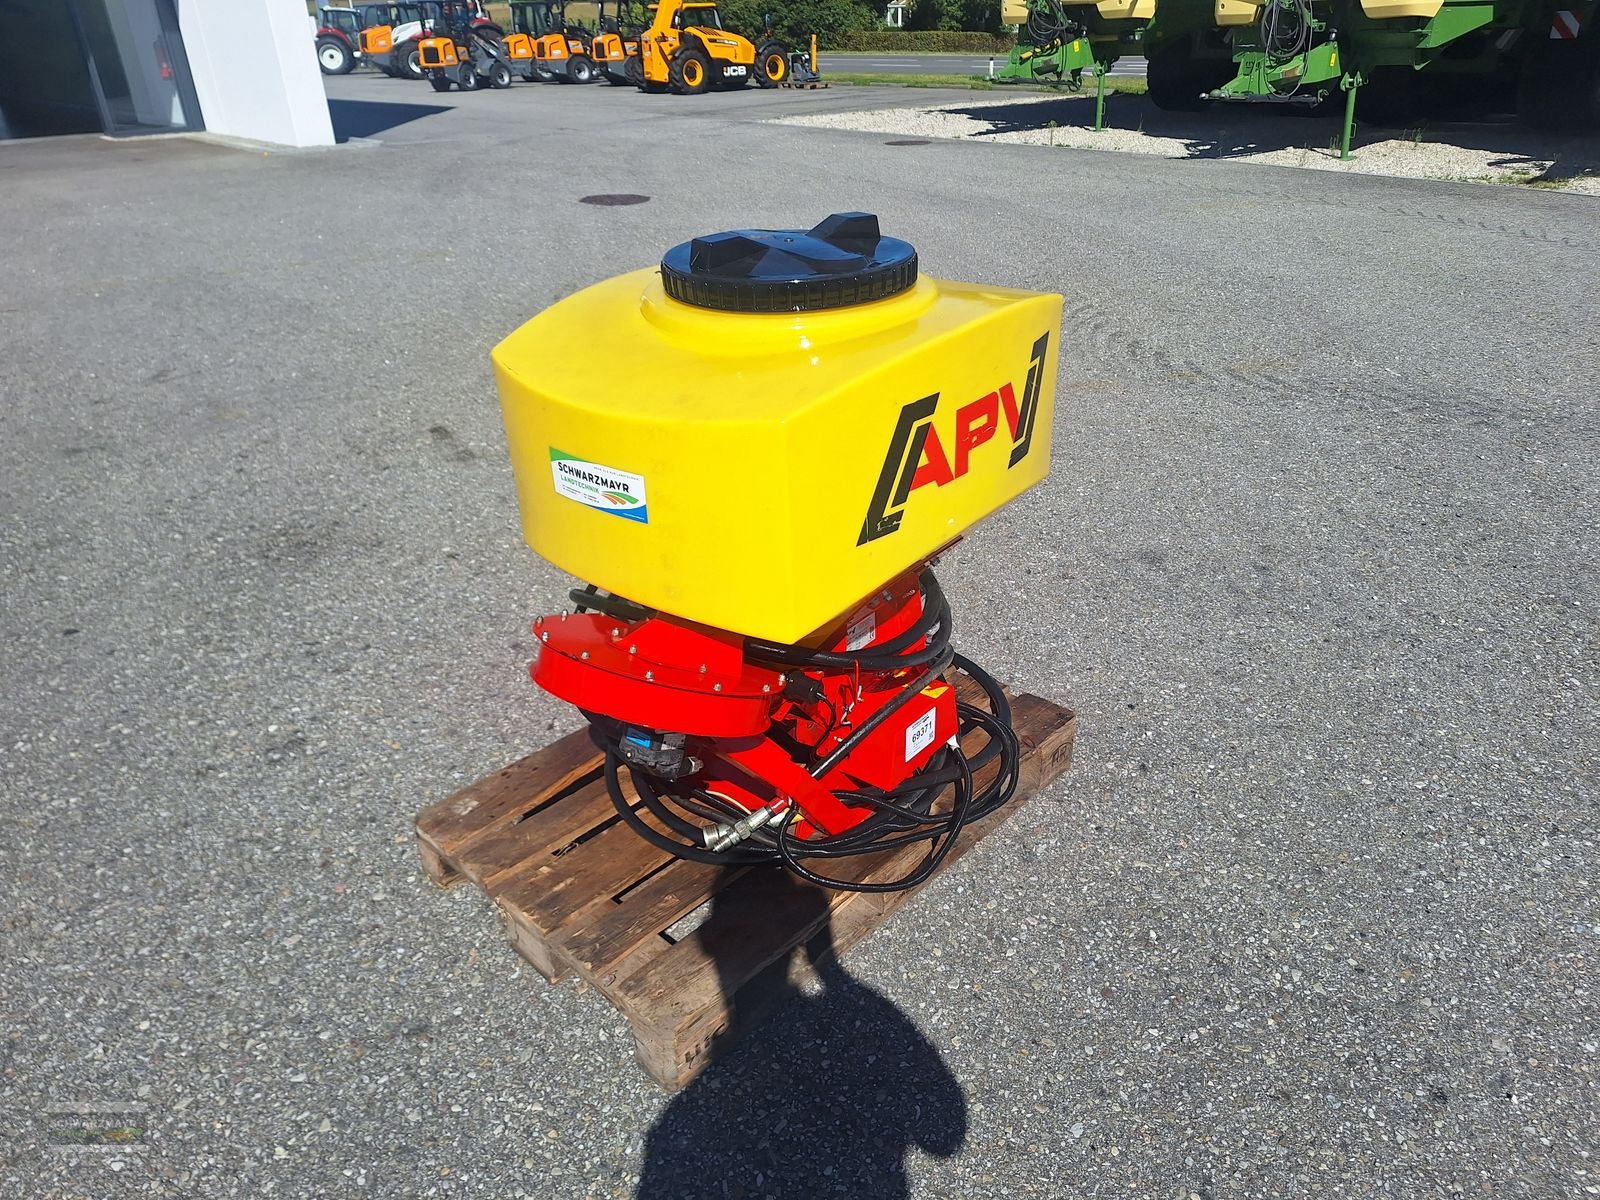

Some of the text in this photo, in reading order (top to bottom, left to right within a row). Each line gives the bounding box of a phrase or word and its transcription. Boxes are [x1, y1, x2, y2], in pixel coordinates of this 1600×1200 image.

[723, 66, 747, 77] JCB
[557, 461, 630, 493] SCHWARZMAYR
[560, 475, 600, 494] LANDTECHNIK
[911, 720, 932, 742] 69371
